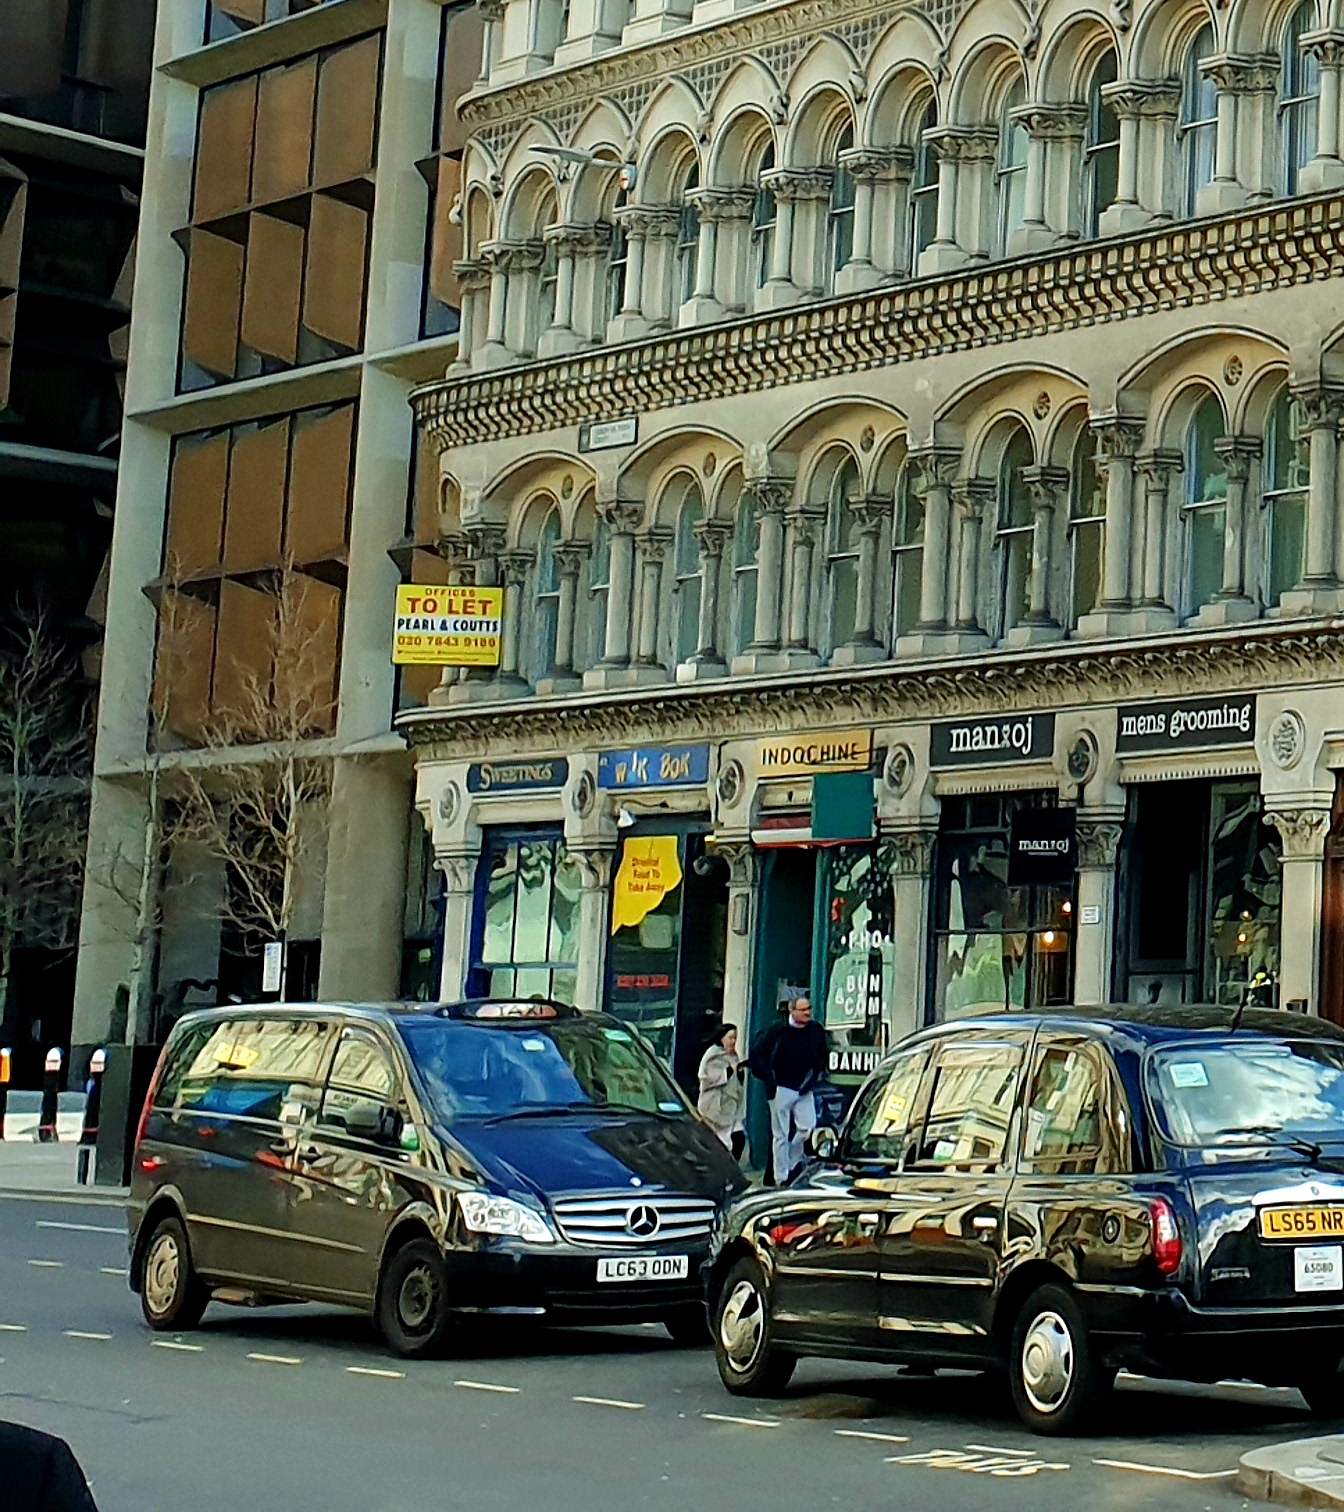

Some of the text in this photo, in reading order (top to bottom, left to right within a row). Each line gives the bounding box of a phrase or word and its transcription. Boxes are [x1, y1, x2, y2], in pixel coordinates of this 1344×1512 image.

[407, 597, 493, 615] TO LET
[398, 618, 498, 632] PEARL & COUTTS
[1121, 704, 1252, 738] mens grooming
[762, 743, 859, 766] INDOCHINE
[1269, 1212, 1317, 1233] LS65
[605, 1259, 648, 1278] LC63
